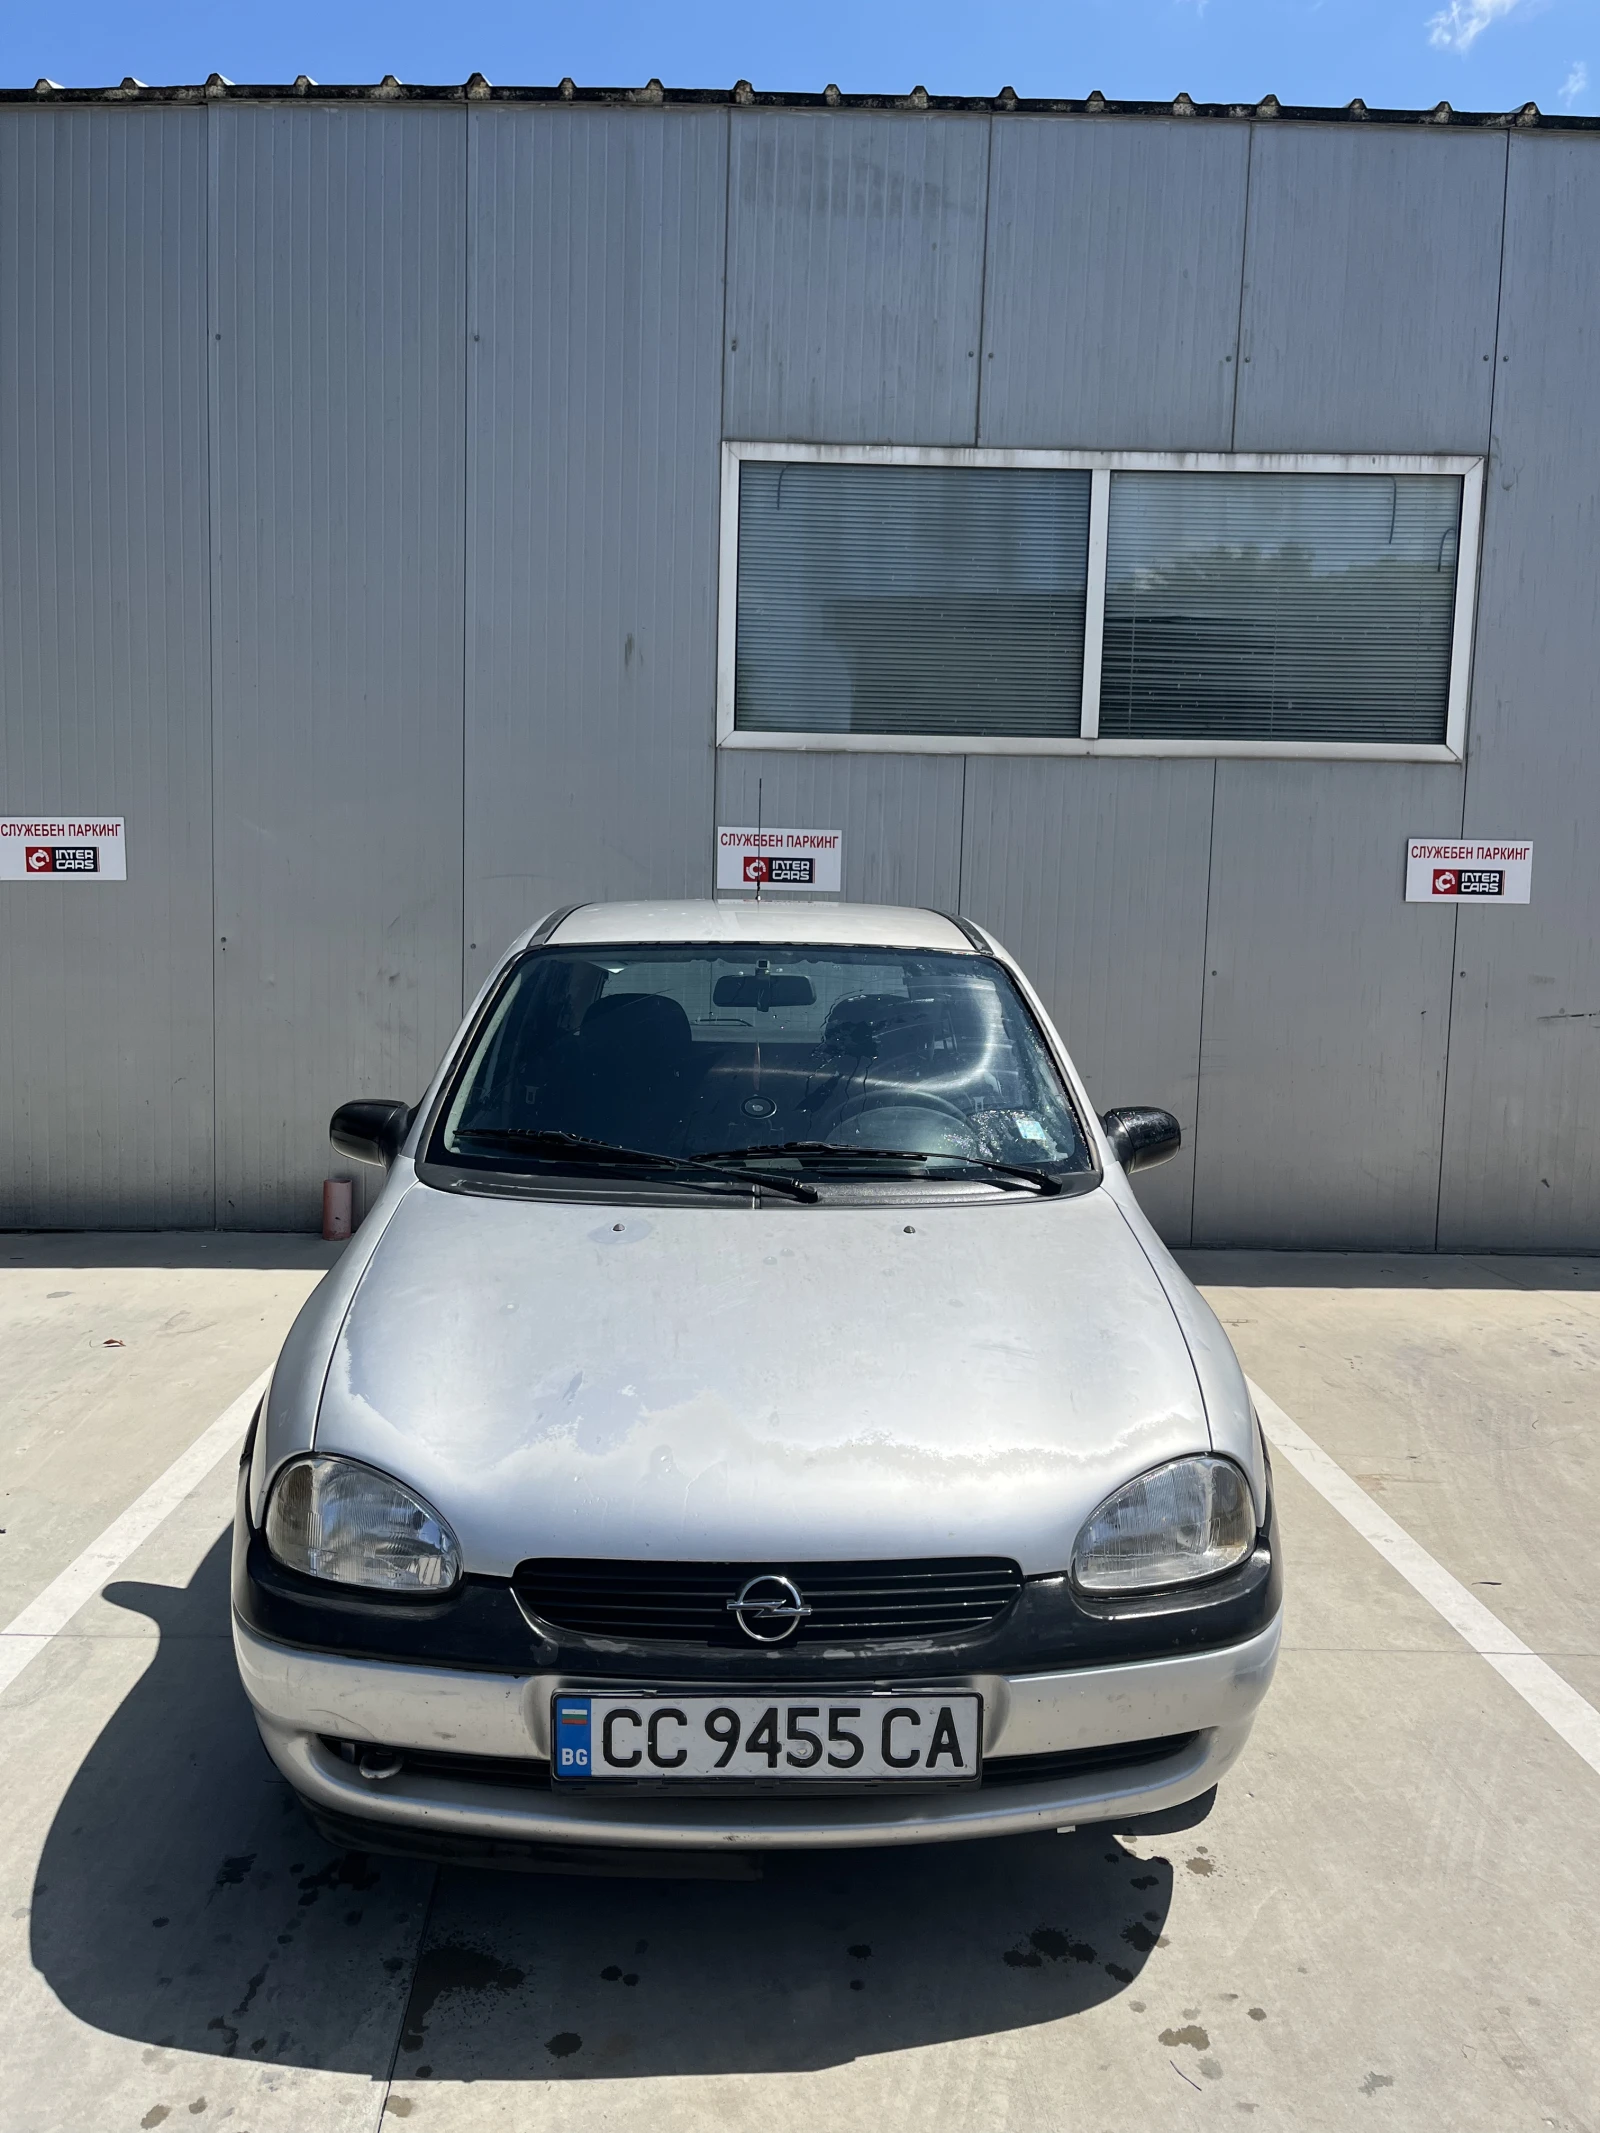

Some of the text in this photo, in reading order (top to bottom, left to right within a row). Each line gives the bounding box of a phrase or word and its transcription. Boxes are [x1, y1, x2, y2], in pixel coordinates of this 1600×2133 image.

[0, 823, 121, 837] СЛУЖЕБЕН ПАРКИНГ
[720, 832, 839, 849] СЛУЖЕБЕН ПАРКИНГ
[55, 849, 94, 860] INTER
[1411, 845, 1530, 861] СЛУЖЕБЕН ПАРКИНГ
[56, 860, 94, 870] CARS
[772, 860, 810, 871] INTER
[772, 870, 810, 881] CARS
[1461, 872, 1500, 883] INTER
[1461, 882, 1499, 893] CARS
[603, 1706, 965, 1769] CC 9455 CA
[562, 1748, 588, 1766] BG
